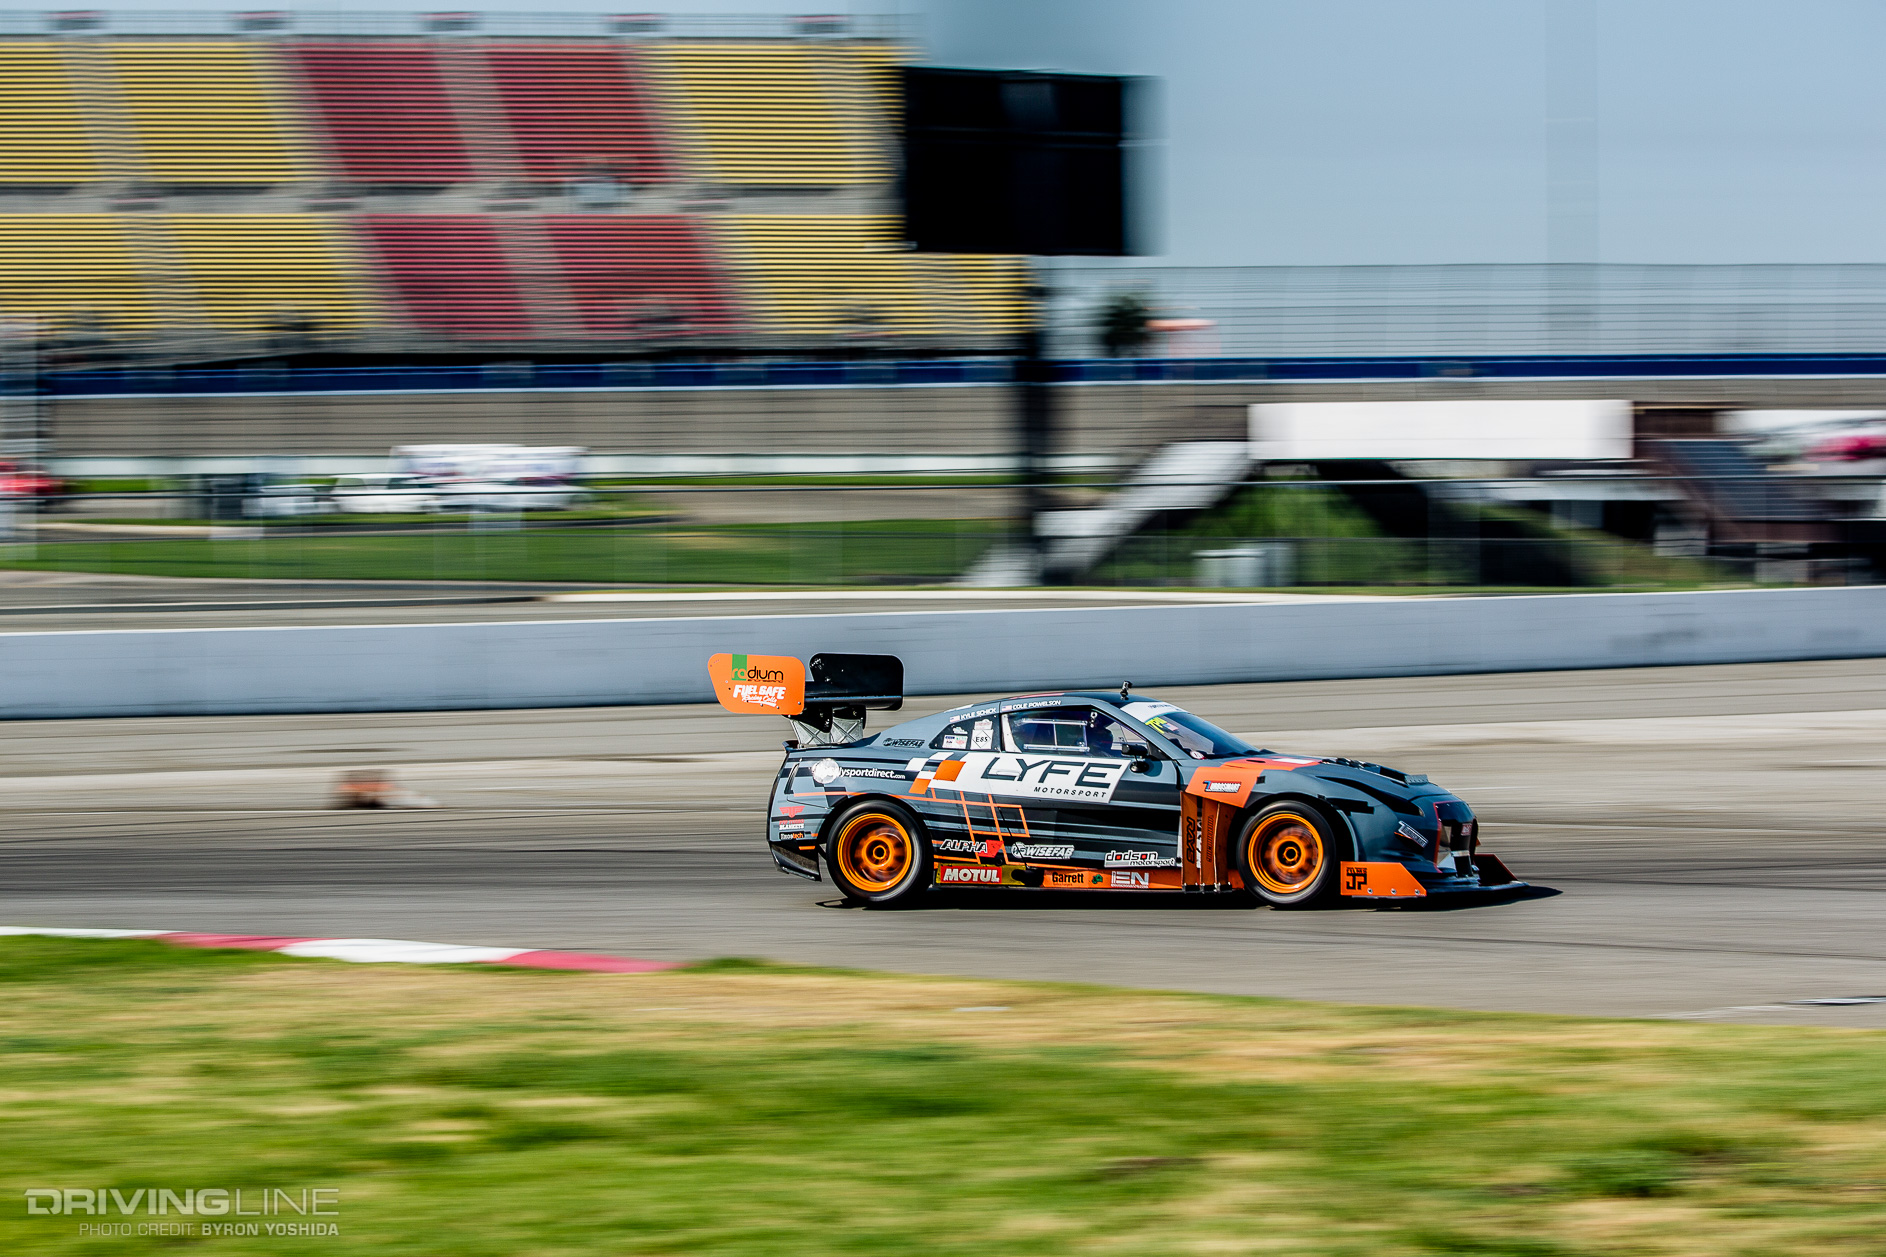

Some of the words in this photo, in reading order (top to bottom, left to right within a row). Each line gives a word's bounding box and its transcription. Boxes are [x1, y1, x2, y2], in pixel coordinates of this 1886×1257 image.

[731, 666, 784, 680] radium
[733, 684, 758, 698] FUEL
[758, 685, 787, 700] SAFE
[1028, 700, 1061, 708] POWELSON
[960, 713, 975, 721] KYLE
[980, 757, 1122, 789] LYFE
[1033, 786, 1107, 798] MOTORSPORT
[940, 839, 987, 853] ALPHA
[1186, 816, 1196, 864] RAYS
[1026, 846, 1075, 857] WISEFAB
[1105, 850, 1157, 861] dodson
[1130, 859, 1175, 868] motorsport
[943, 868, 1000, 882] MOTUL
[1052, 871, 1084, 883] Garrett
